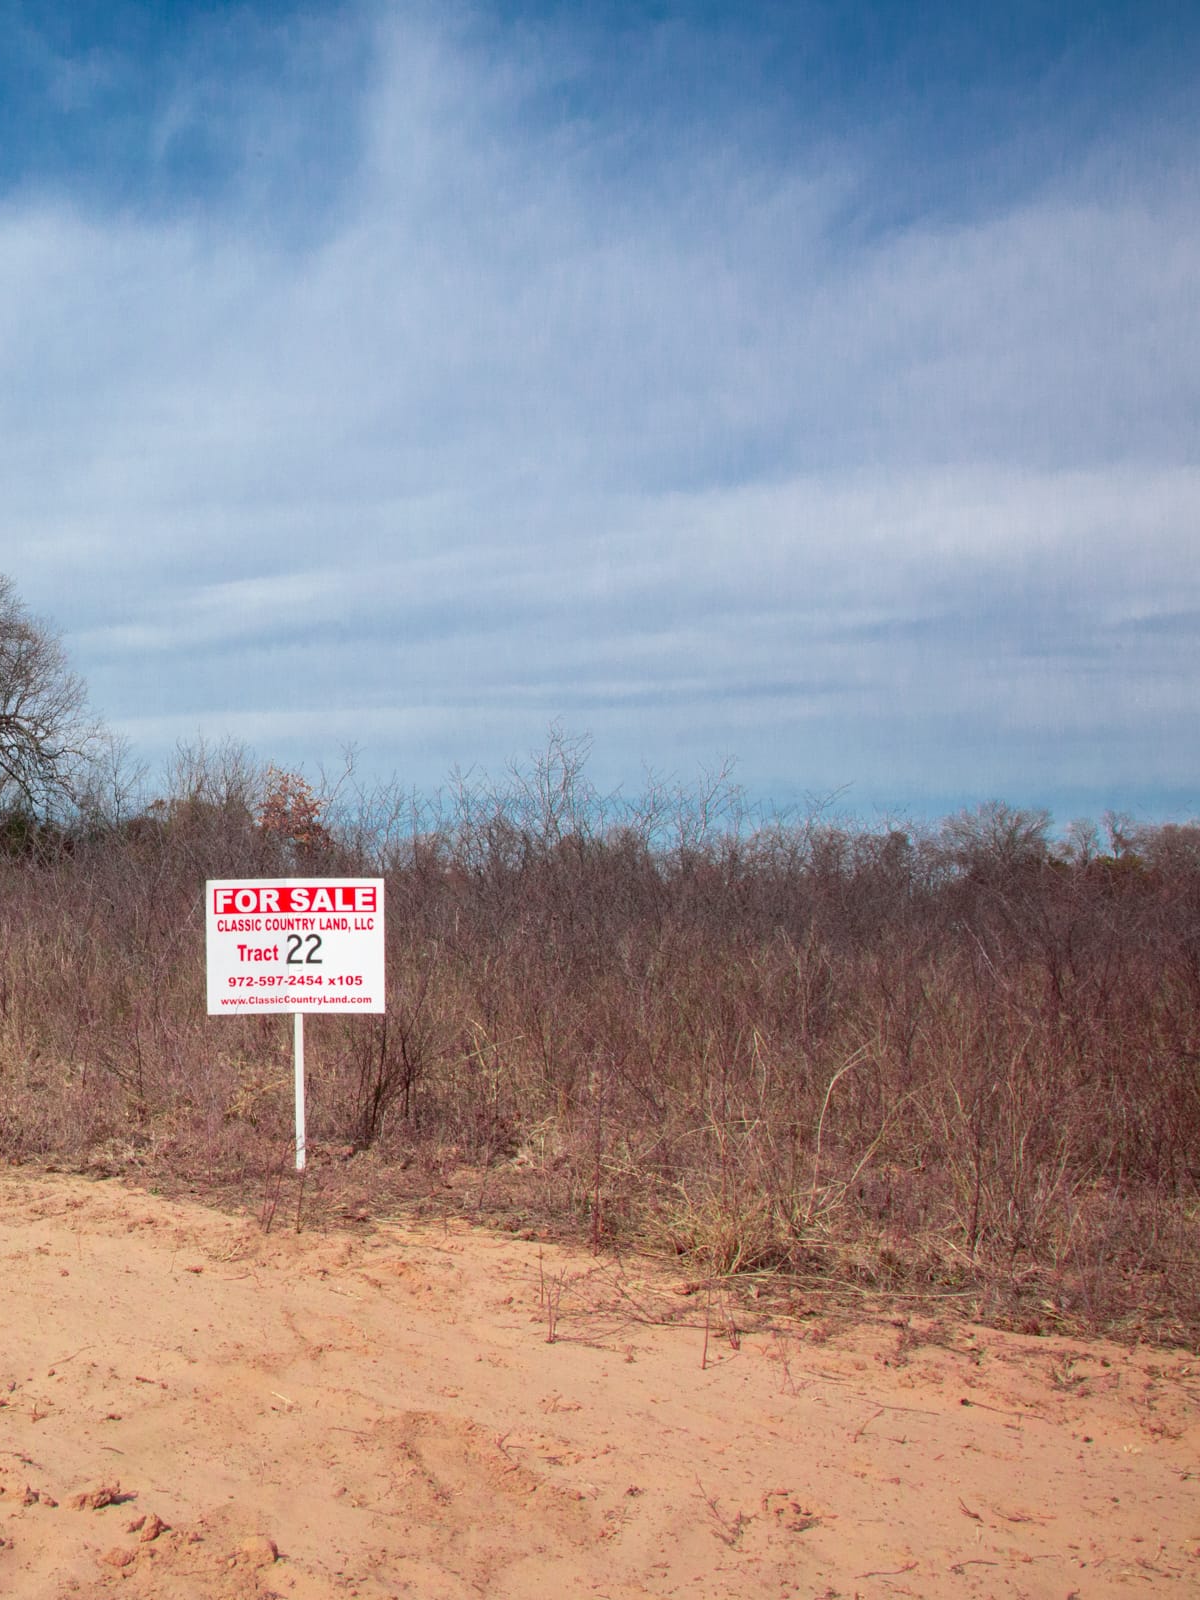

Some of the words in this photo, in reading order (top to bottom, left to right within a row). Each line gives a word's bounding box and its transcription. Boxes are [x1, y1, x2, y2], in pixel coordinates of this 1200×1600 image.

[216, 889, 280, 913] FOR
[290, 888, 374, 912] SALE
[217, 918, 262, 932] CLASSIC
[265, 918, 315, 931] COUNTRY
[319, 918, 351, 933] LAND,
[354, 918, 374, 930] LLC
[237, 944, 279, 961] Tract
[286, 933, 323, 964] 22
[228, 975, 323, 987] 972-597-2454
[328, 975, 363, 986] x105
[220, 995, 372, 1005] www.ClassicCountryLand.com
